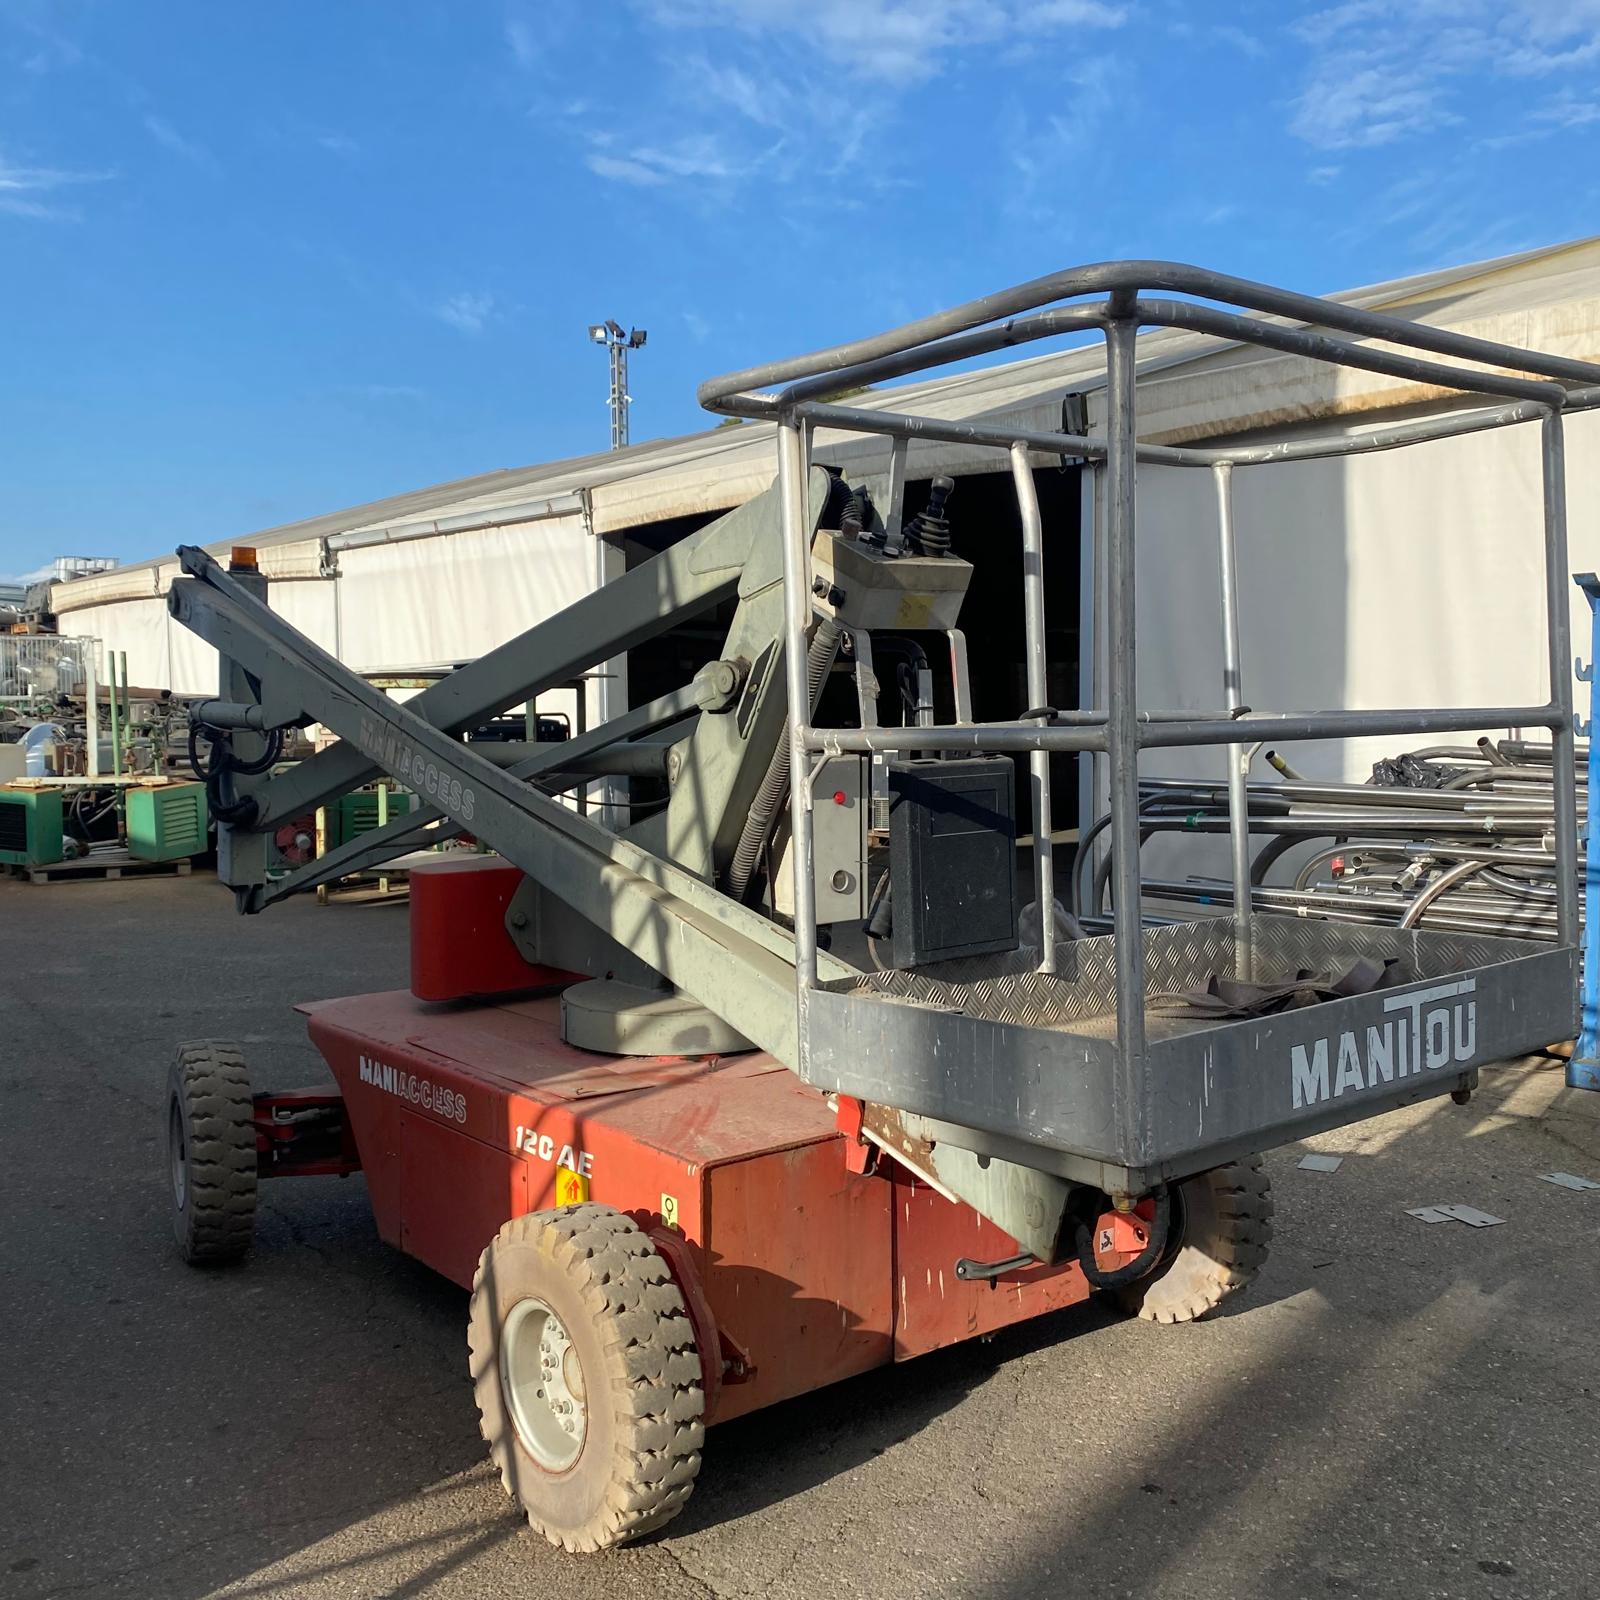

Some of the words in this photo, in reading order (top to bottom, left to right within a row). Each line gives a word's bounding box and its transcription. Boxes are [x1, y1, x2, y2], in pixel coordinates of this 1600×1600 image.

[1291, 978, 1476, 1110] MANITOU
[359, 1055, 467, 1124] MANIACCESS
[515, 1125, 554, 1162] 120
[556, 1144, 595, 1179] AE
